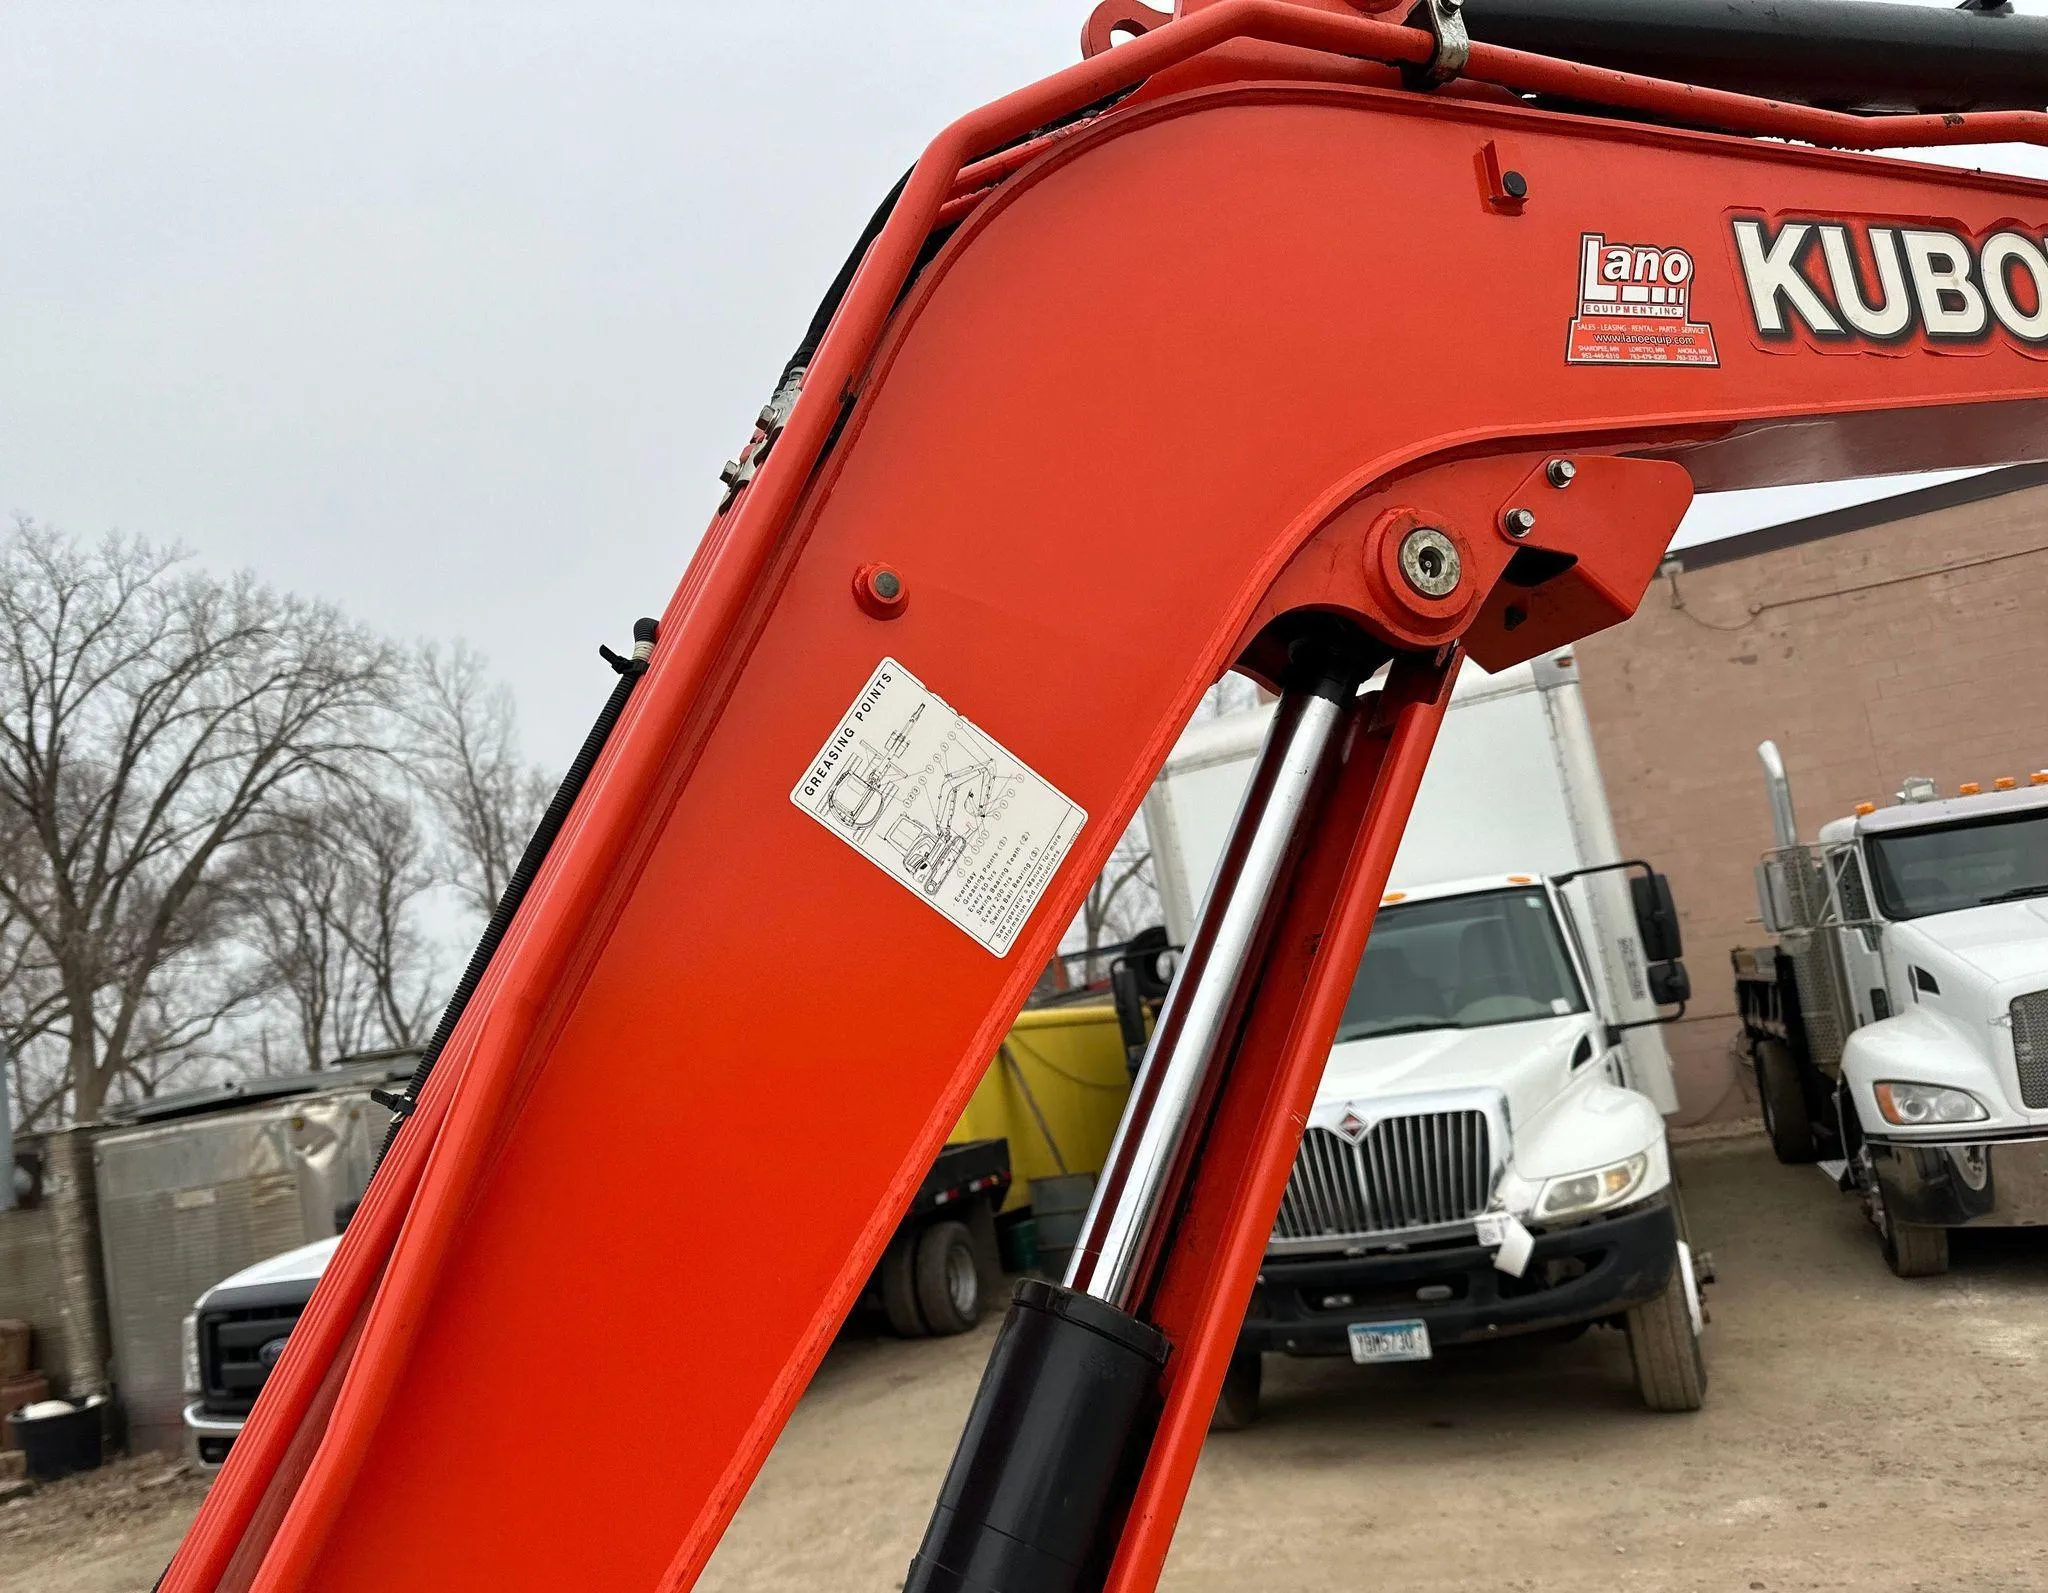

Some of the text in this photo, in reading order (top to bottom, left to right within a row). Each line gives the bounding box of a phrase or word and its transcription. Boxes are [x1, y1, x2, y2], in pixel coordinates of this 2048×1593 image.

[1584, 240, 1689, 301] Lano
[1733, 221, 2048, 338] KUBO
[1577, 323, 1596, 331] SALES
[1658, 325, 1677, 333] PARTS
[1681, 326, 1705, 334] SERVICE
[1593, 332, 1695, 346] www.lanoequip.com
[804, 673, 892, 796] GREASING POINTS
[954, 871, 977, 903] Everyday
[962, 874, 985, 905] Greasing
[982, 852, 999, 874] Points
[967, 870, 997, 913] Every 50 hrs
[975, 894, 992, 916] Swing
[989, 867, 1009, 894] Bearing
[980, 876, 1013, 923] Every 200 hrs
[989, 905, 1006, 926] Swing
[1011, 862, 1032, 889] Bearing
[1026, 889, 1036, 904] and
[995, 925, 1007, 939] See
